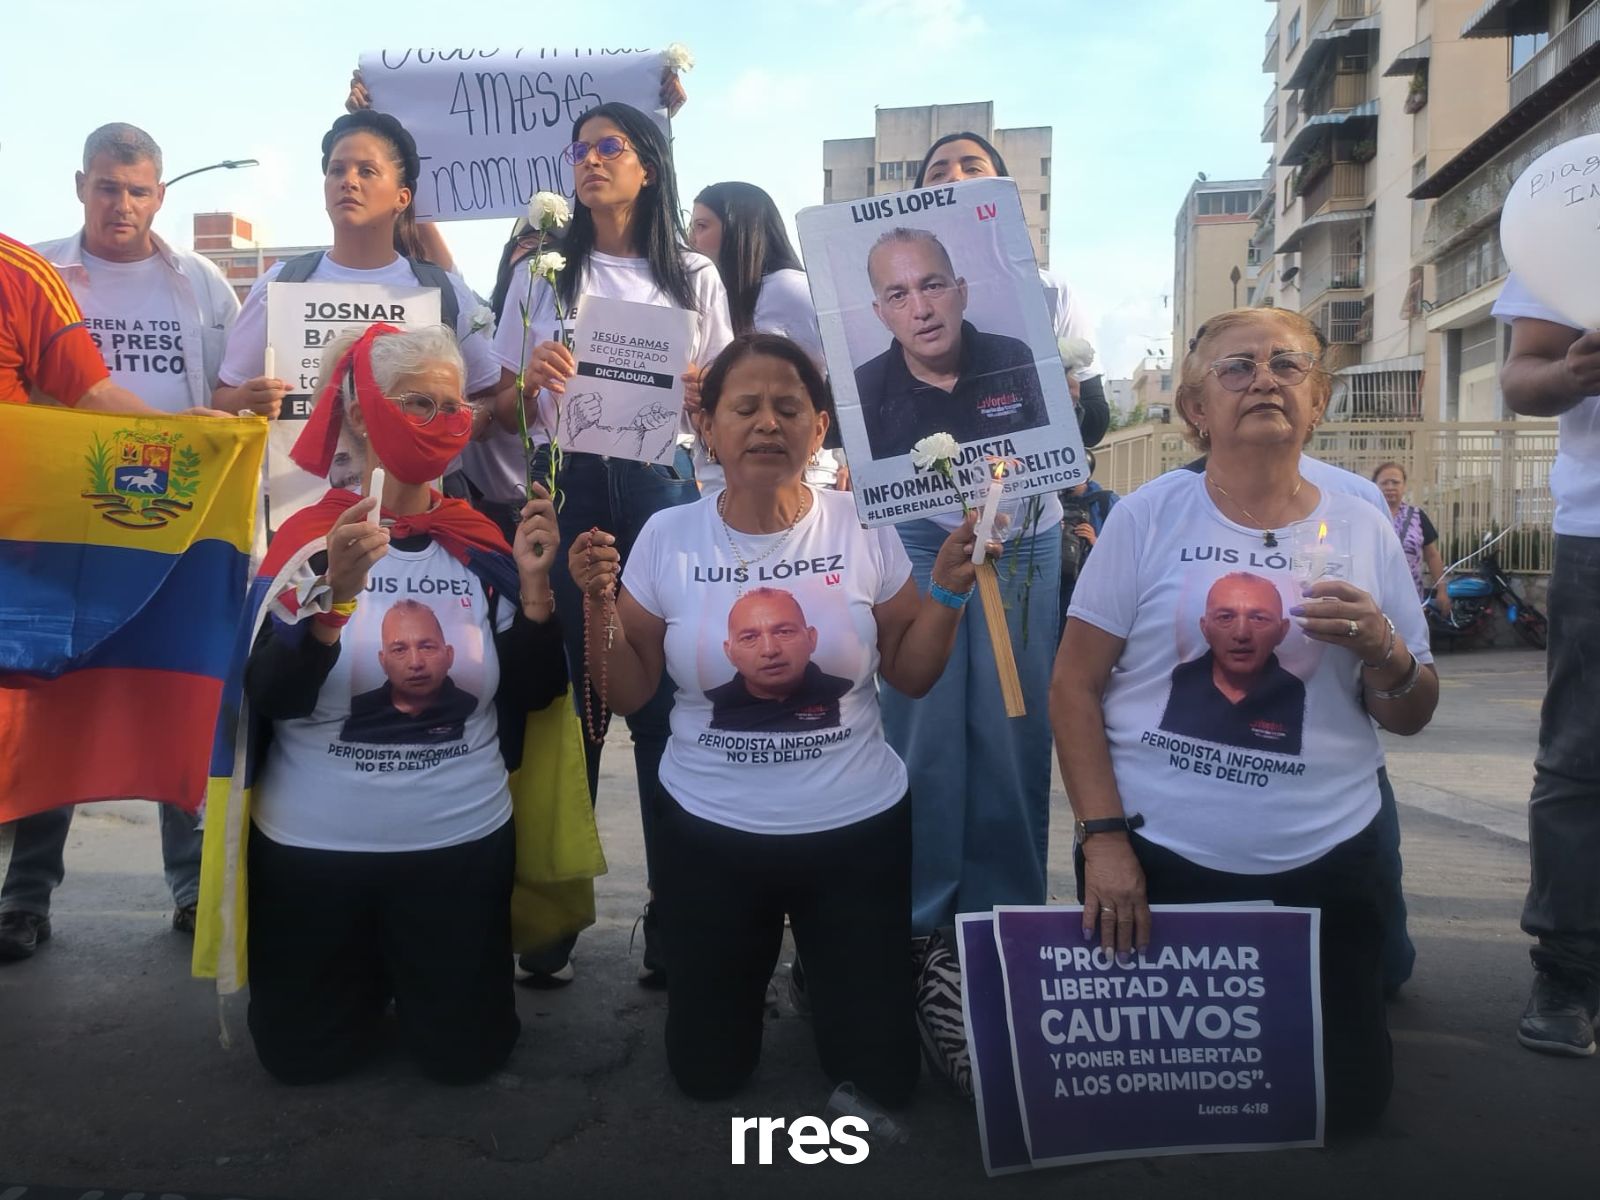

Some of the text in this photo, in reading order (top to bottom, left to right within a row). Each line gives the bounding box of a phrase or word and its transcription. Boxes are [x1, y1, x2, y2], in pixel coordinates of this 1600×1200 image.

[851, 187, 957, 223] LUIS LOPEZ
[976, 203, 997, 221] LV
[304, 303, 405, 320] JOSNAR
[133, 320, 144, 330] A
[592, 331, 626, 344] JESÚS
[629, 337, 670, 351] ARMAS
[590, 344, 668, 363] SECUESTRADO
[608, 356, 646, 370] POR LA
[595, 367, 655, 385] DICTADURA
[1180, 546, 1239, 564] LUIS
[694, 554, 845, 583] LUIS LÓPEZ
[407, 575, 473, 596] LÓPEZ
[825, 573, 841, 586] LV
[698, 728, 852, 751] PERIODISTA INFORMAR
[328, 743, 469, 761] PERIODISTA INFORMAR
[726, 748, 822, 764] NO ES DELITO
[1141, 731, 1306, 776] PERIODISTA INFORMAR
[355, 758, 440, 772] NO ES DELITO
[1169, 755, 1269, 788] NO ES DELITO
[1040, 976, 1265, 1001] LIBERTAD A LOS
[1040, 1005, 1262, 1045] CAUTIVOS
[1050, 1047, 1262, 1070] Y PONER EN LIBERTAD
[1054, 1077, 1069, 1098] A
[1072, 1075, 1112, 1097] LOS
[1198, 1103, 1269, 1115] Lucas 4:18
